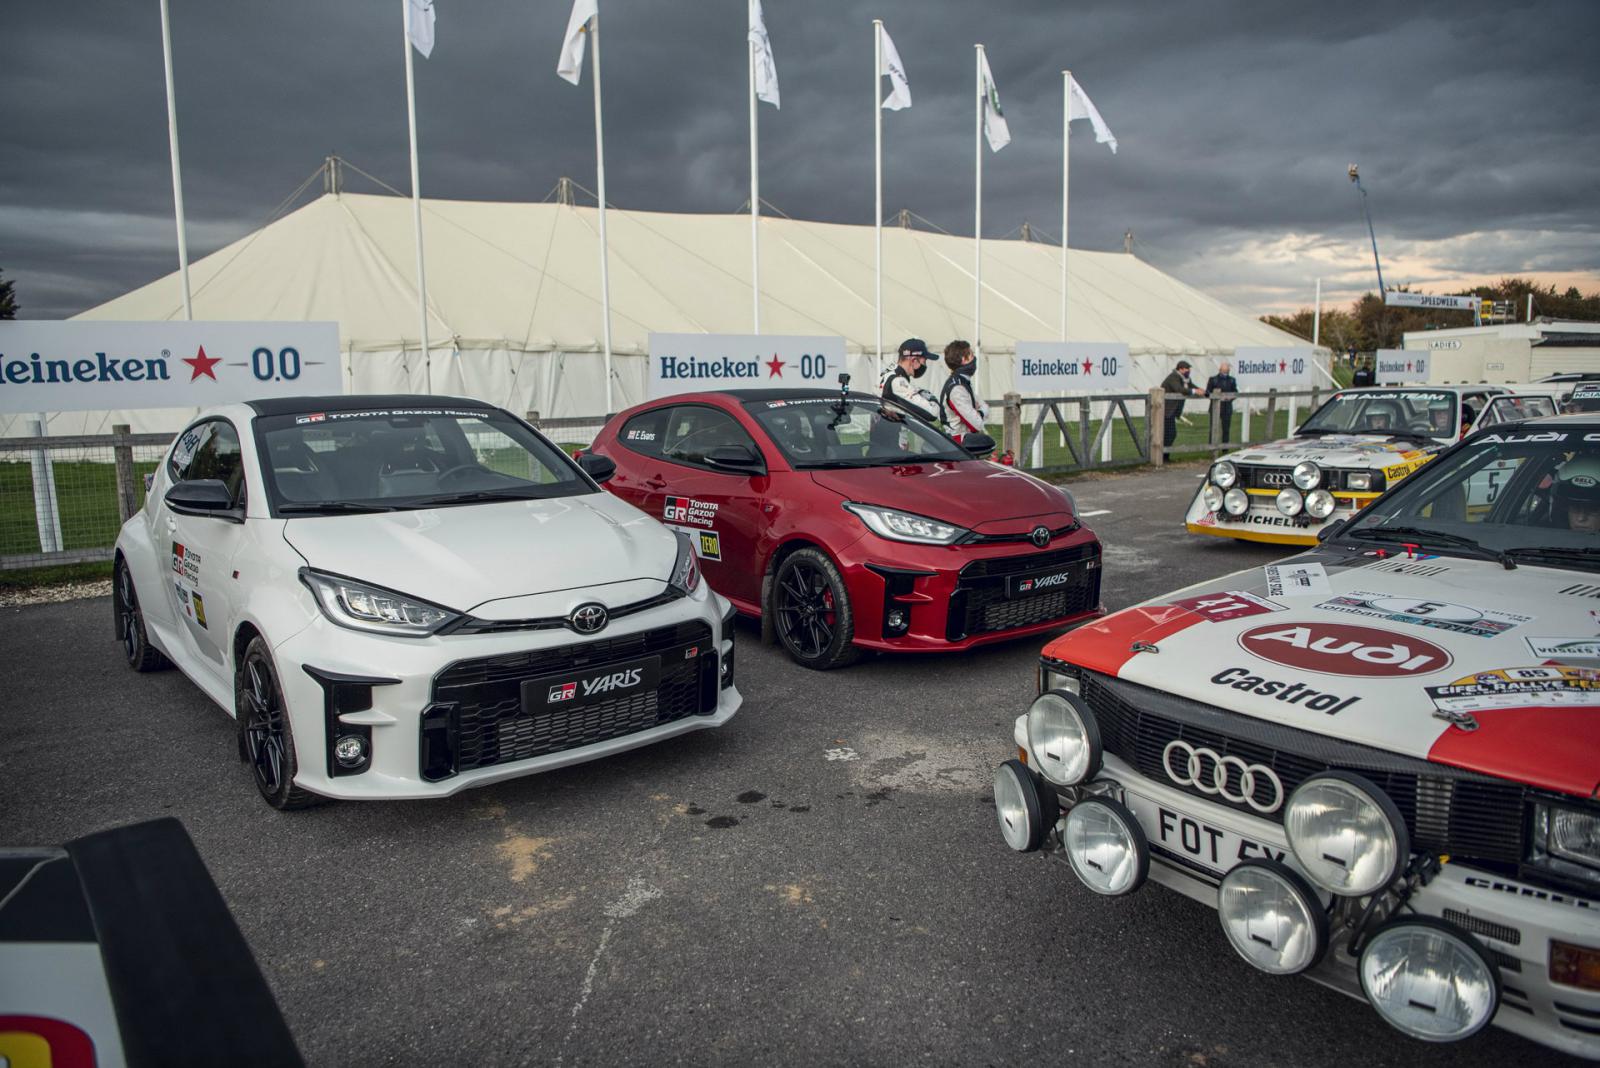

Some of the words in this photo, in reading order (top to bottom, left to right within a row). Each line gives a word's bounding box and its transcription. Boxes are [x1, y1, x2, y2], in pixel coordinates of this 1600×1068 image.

[0, 352, 170, 384] eineken
[252, 347, 301, 382] 0.0
[660, 356, 760, 379] Heineken
[801, 354, 826, 380] 0.0
[1021, 358, 1078, 376] Heineken
[1238, 360, 1277, 374] Heineken
[329, 410, 389, 419] TOYOTA
[445, 410, 489, 419] Racing
[1487, 472, 1500, 503] 5
[1574, 477, 1593, 485] BELL
[664, 505, 687, 521] GR
[688, 507, 715, 518] GAZOO
[690, 499, 719, 511] TOYOTA
[687, 515, 713, 528] Racing
[701, 535, 719, 555] ZERO
[1034, 572, 1069, 589] YARIS
[1405, 602, 1446, 616] 5
[1517, 669, 1550, 678] 85
[549, 685, 576, 703] GR
[1210, 667, 1363, 716] Castrol
[1437, 683, 1489, 695] EIFEL
[1494, 680, 1565, 691] RALLYE
[1158, 806, 1224, 864] FOT
